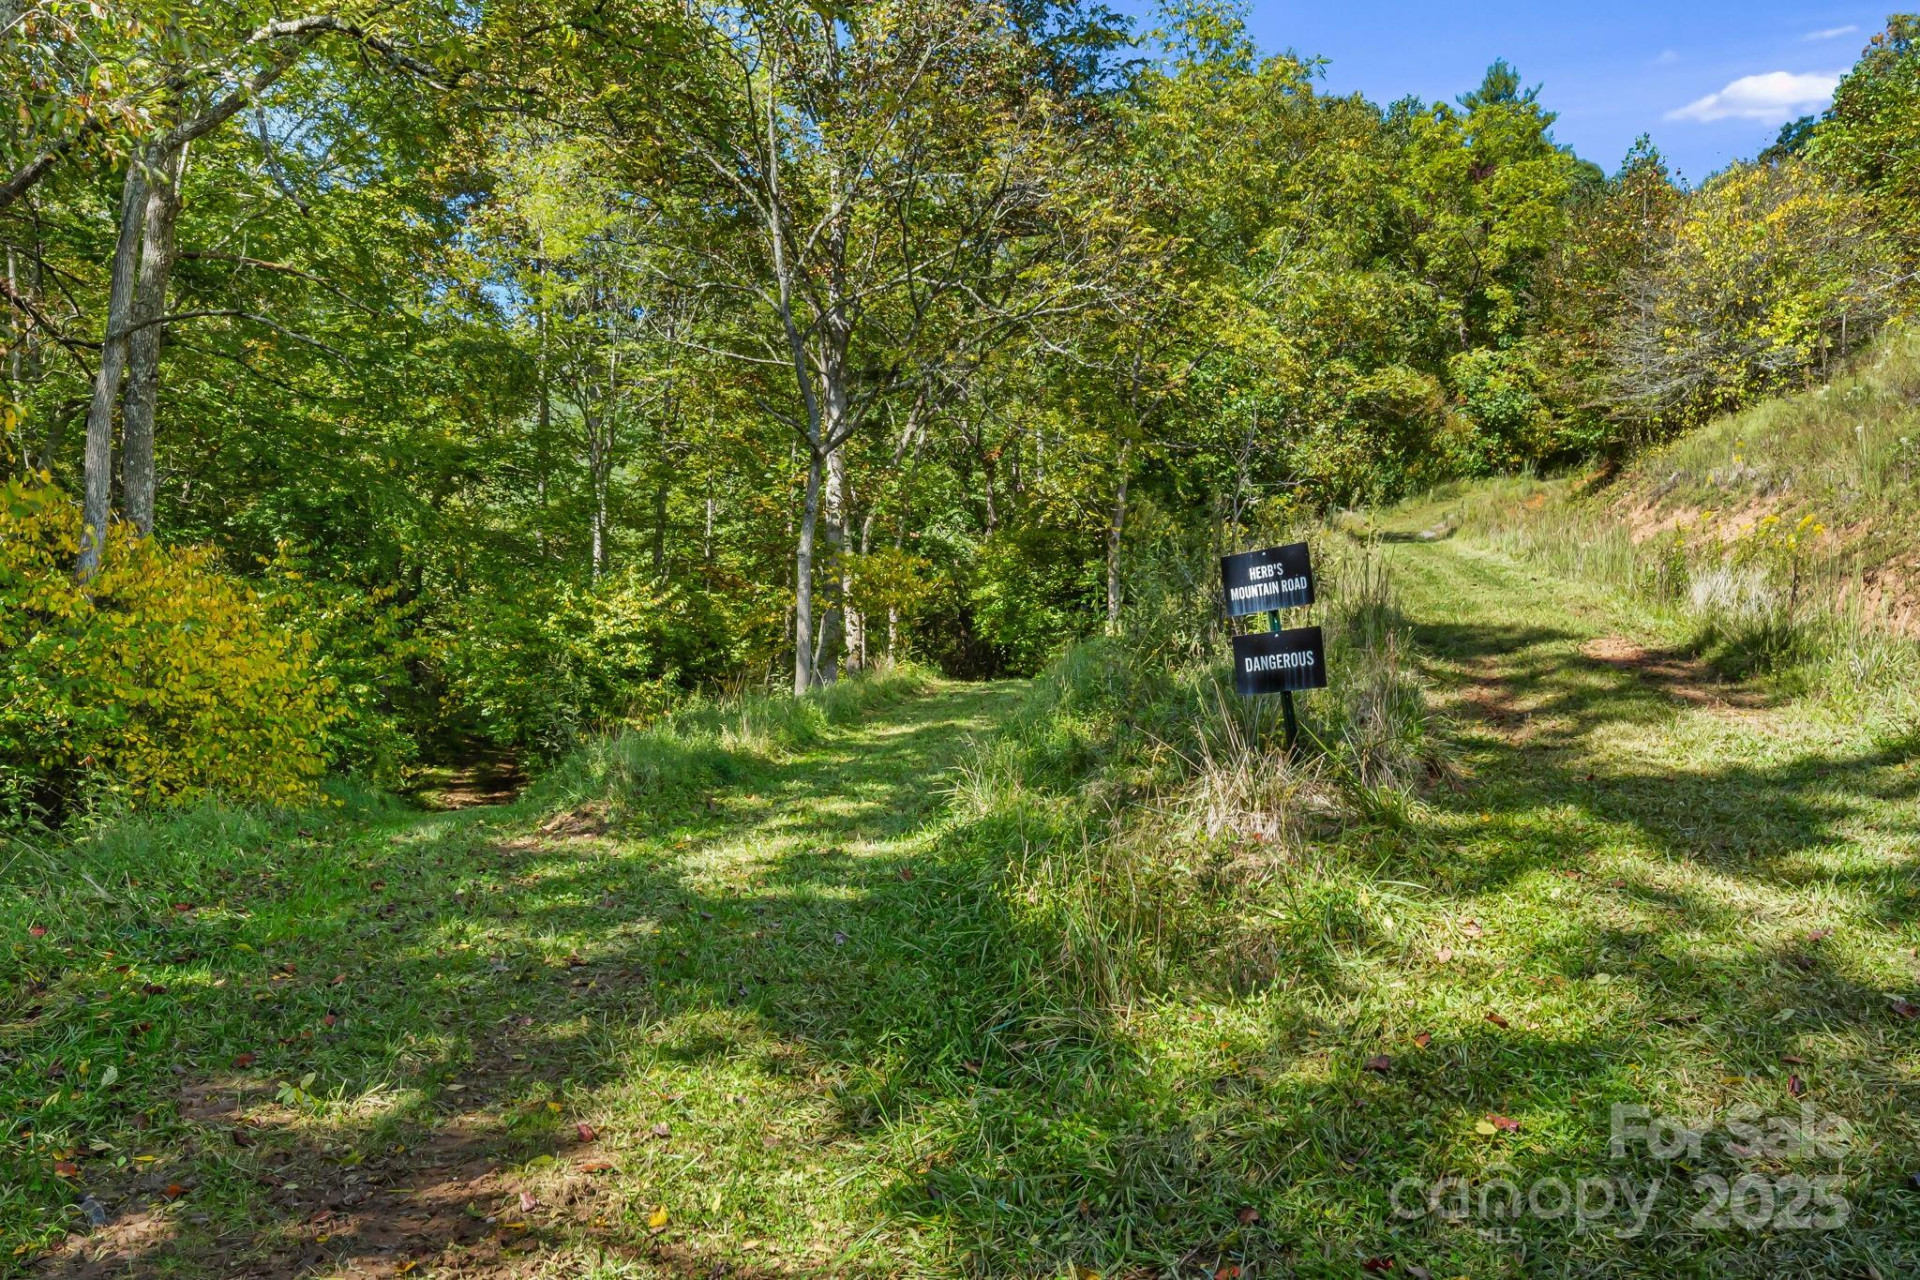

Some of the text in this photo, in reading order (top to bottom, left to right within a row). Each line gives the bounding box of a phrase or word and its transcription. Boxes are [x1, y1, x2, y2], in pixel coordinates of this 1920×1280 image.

[1249, 562, 1283, 580] HERB'S
[1230, 577, 1307, 601] MOUNTAIN ROAD
[1245, 651, 1315, 672] DANGEROUS
